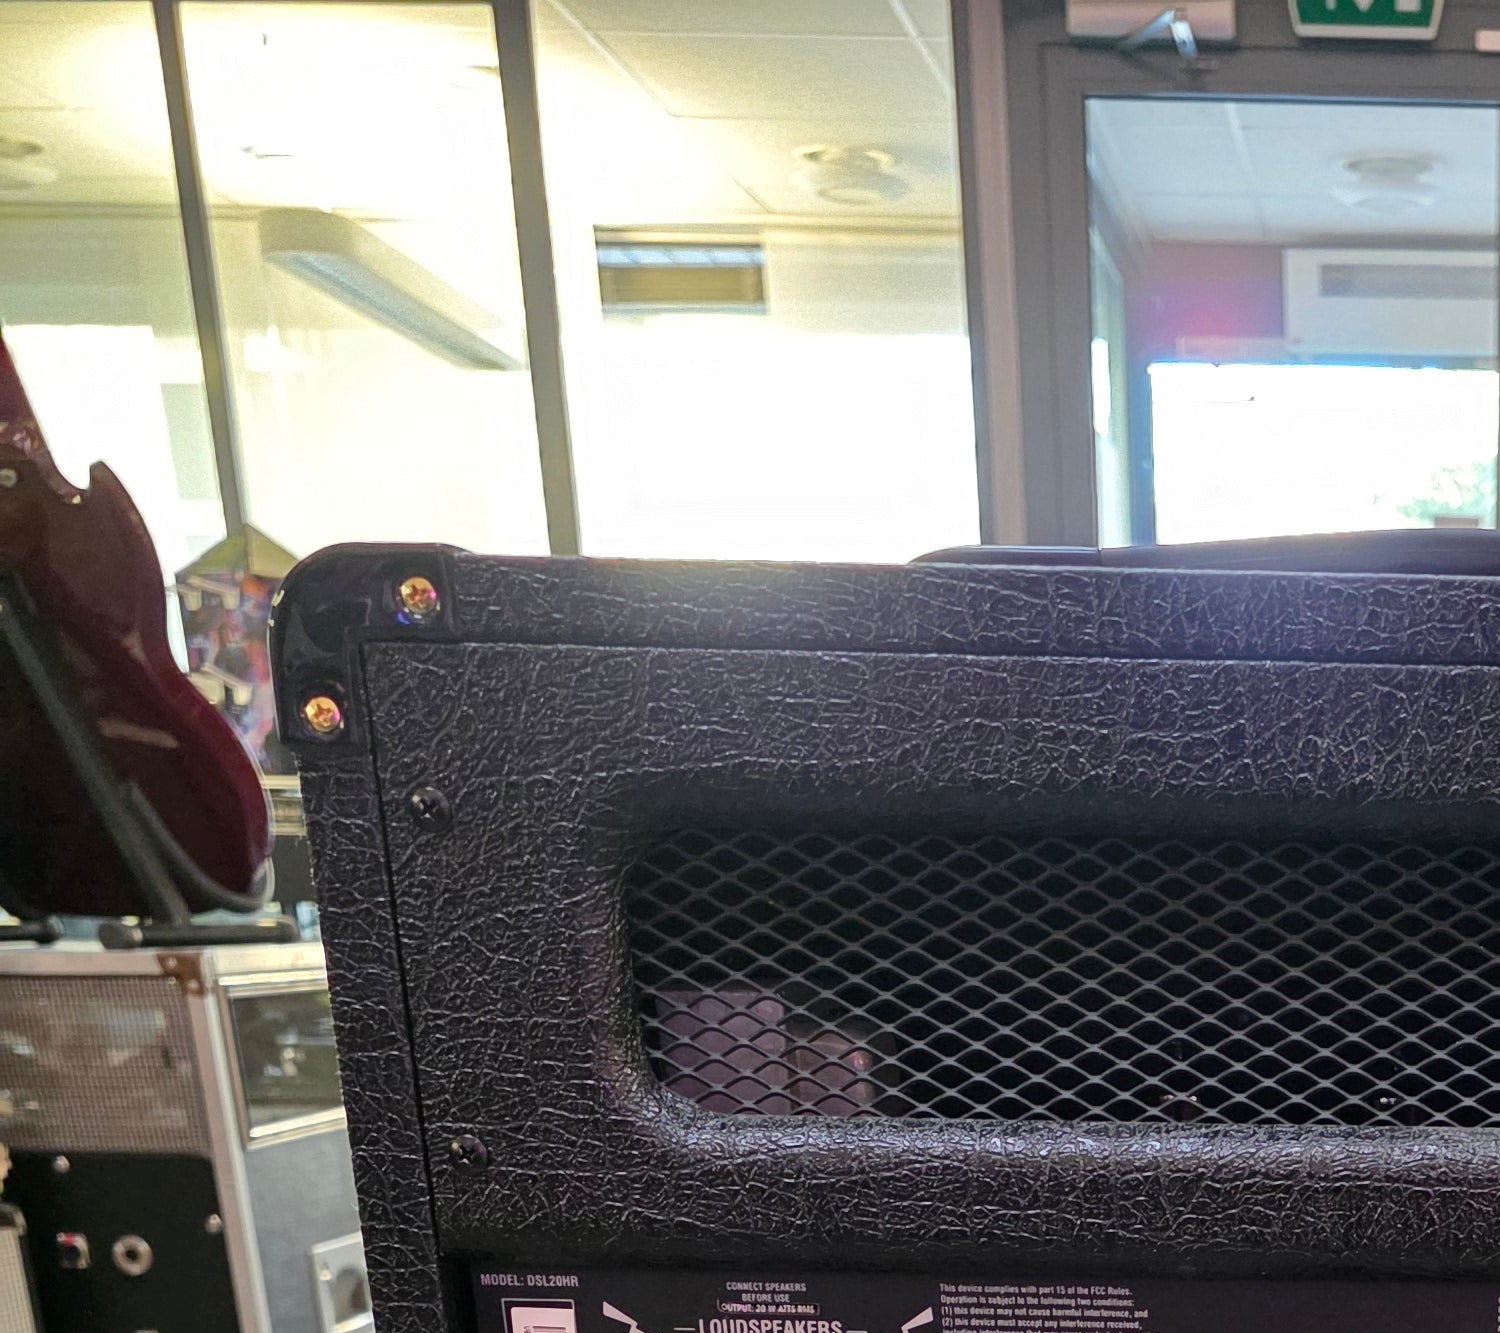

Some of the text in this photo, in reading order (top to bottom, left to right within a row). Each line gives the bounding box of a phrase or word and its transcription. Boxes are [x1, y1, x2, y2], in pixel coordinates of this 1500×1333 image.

[481, 1274, 578, 1287] MODEL: DSL20HR
[726, 1282, 806, 1292] CONNECT SPEAKERS
[940, 1283, 956, 1293] This
[958, 1284, 982, 1293] device
[984, 1285, 1019, 1294] complies
[1077, 1286, 1089, 1295] the
[1091, 1286, 1106, 1295] FCC
[742, 1293, 789, 1303] BEFORE USE
[979, 1296, 986, 1304] is
[1026, 1296, 1039, 1305] the
[1077, 1298, 1091, 1306] two
[954, 1306, 968, 1316] this
[970, 1307, 995, 1315] device
[997, 1309, 1013, 1317] may
[1134, 1310, 1148, 1318] and
[955, 1318, 969, 1326] this
[971, 1318, 995, 1327] device
[1044, 1321, 1058, 1329] any
